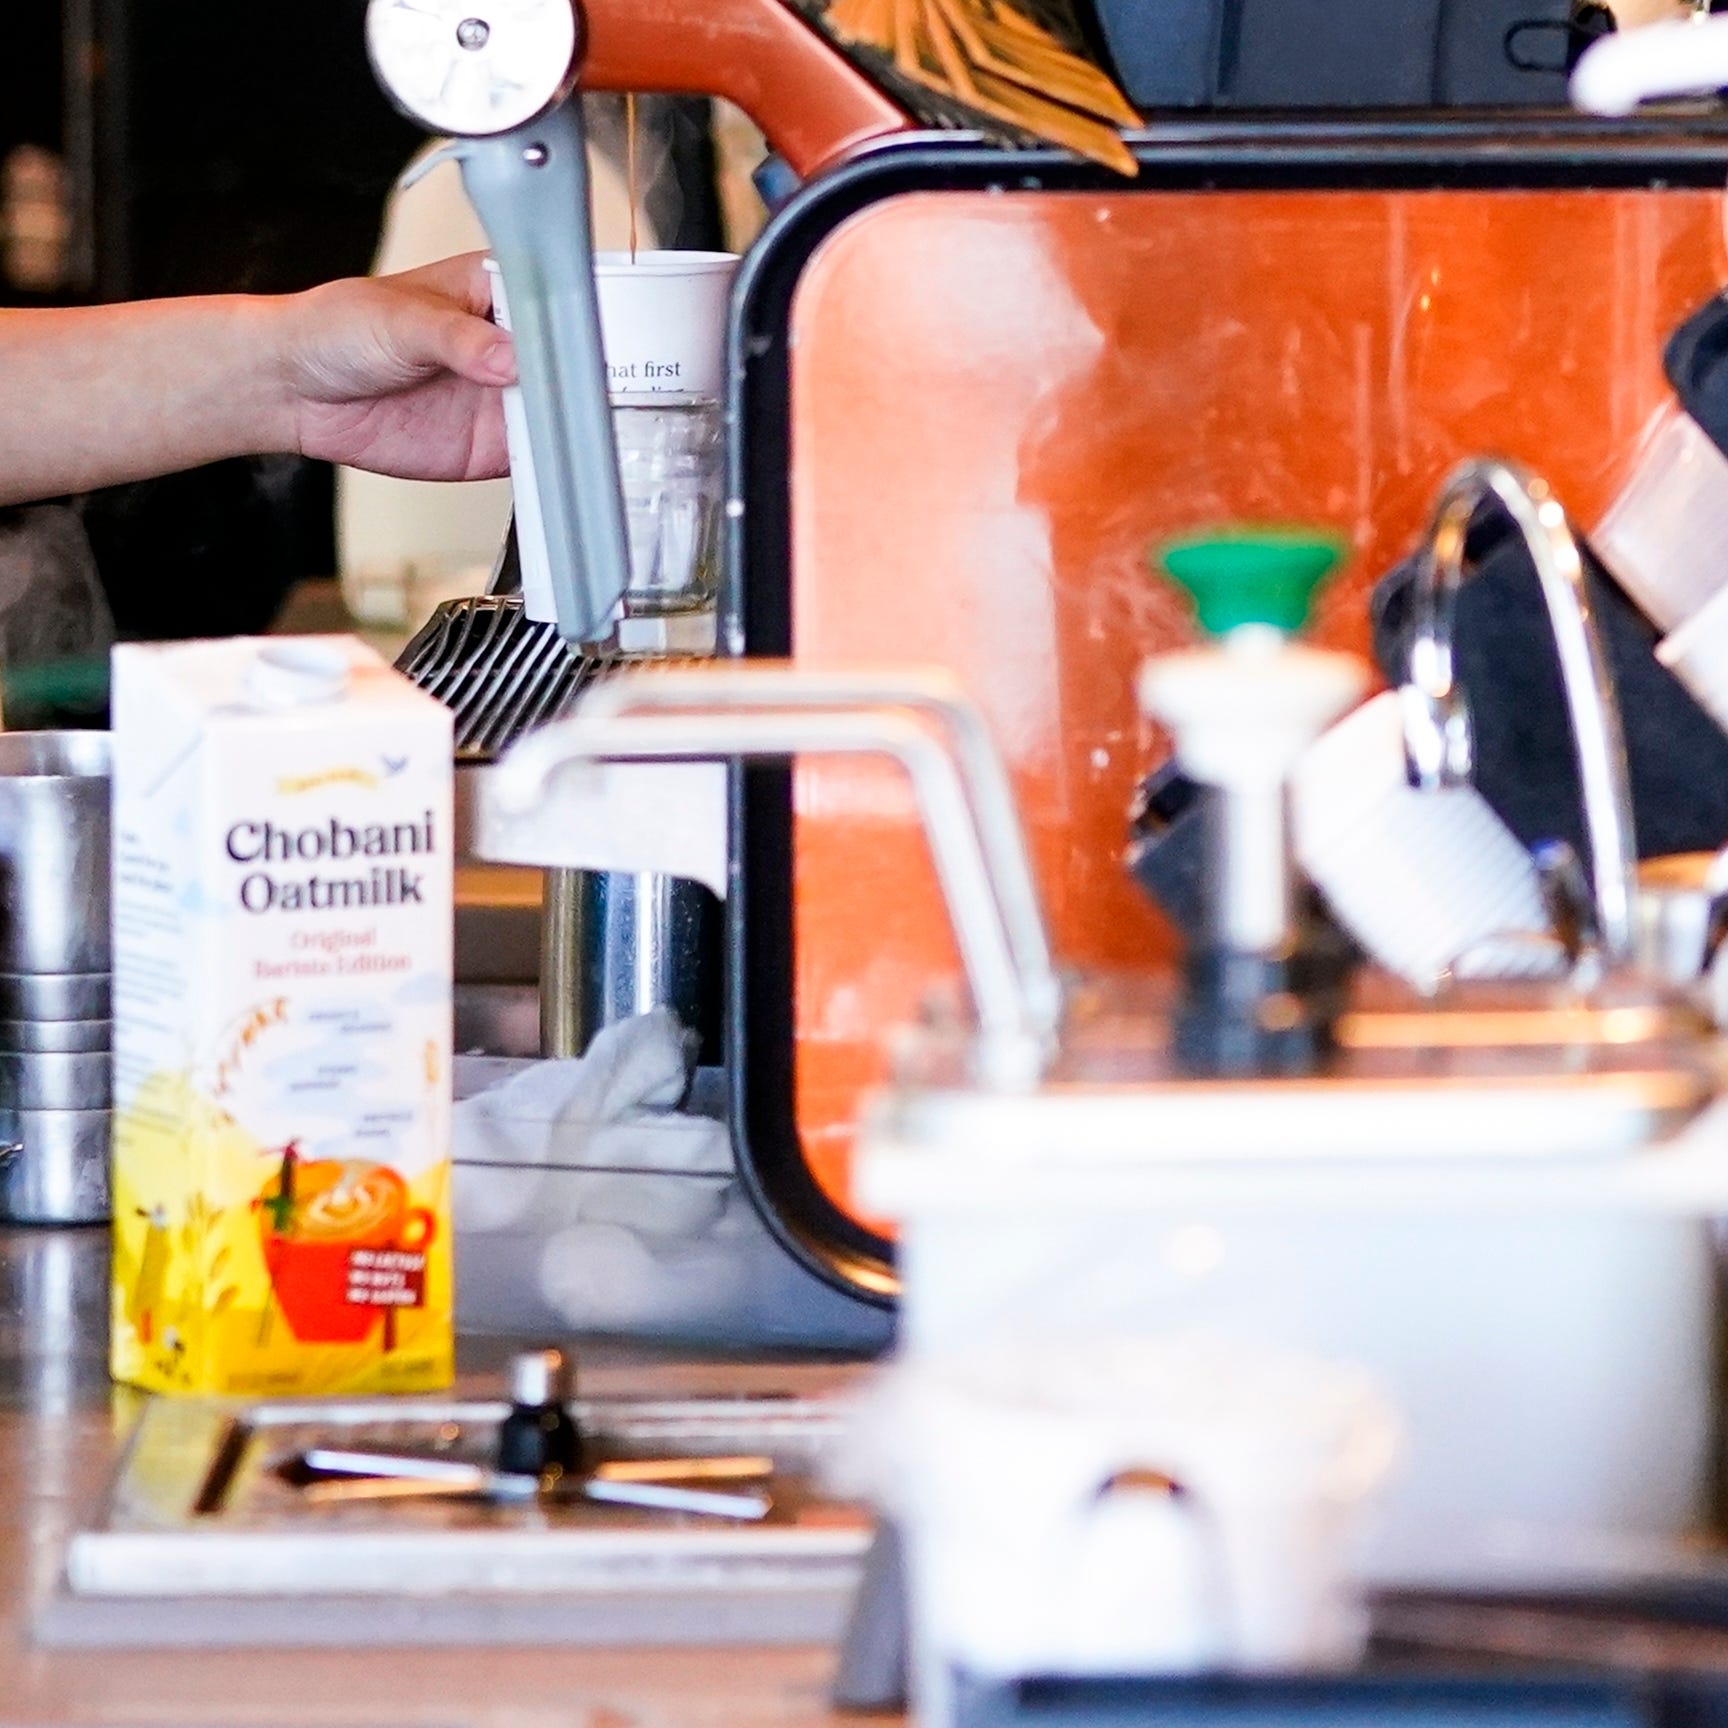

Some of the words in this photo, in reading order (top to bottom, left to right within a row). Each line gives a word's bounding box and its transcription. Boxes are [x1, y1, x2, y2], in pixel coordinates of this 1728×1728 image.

[644, 360, 681, 378] first
[226, 809, 434, 862] Chobani
[240, 867, 423, 914] Oatmilk
[290, 927, 377, 952] Original
